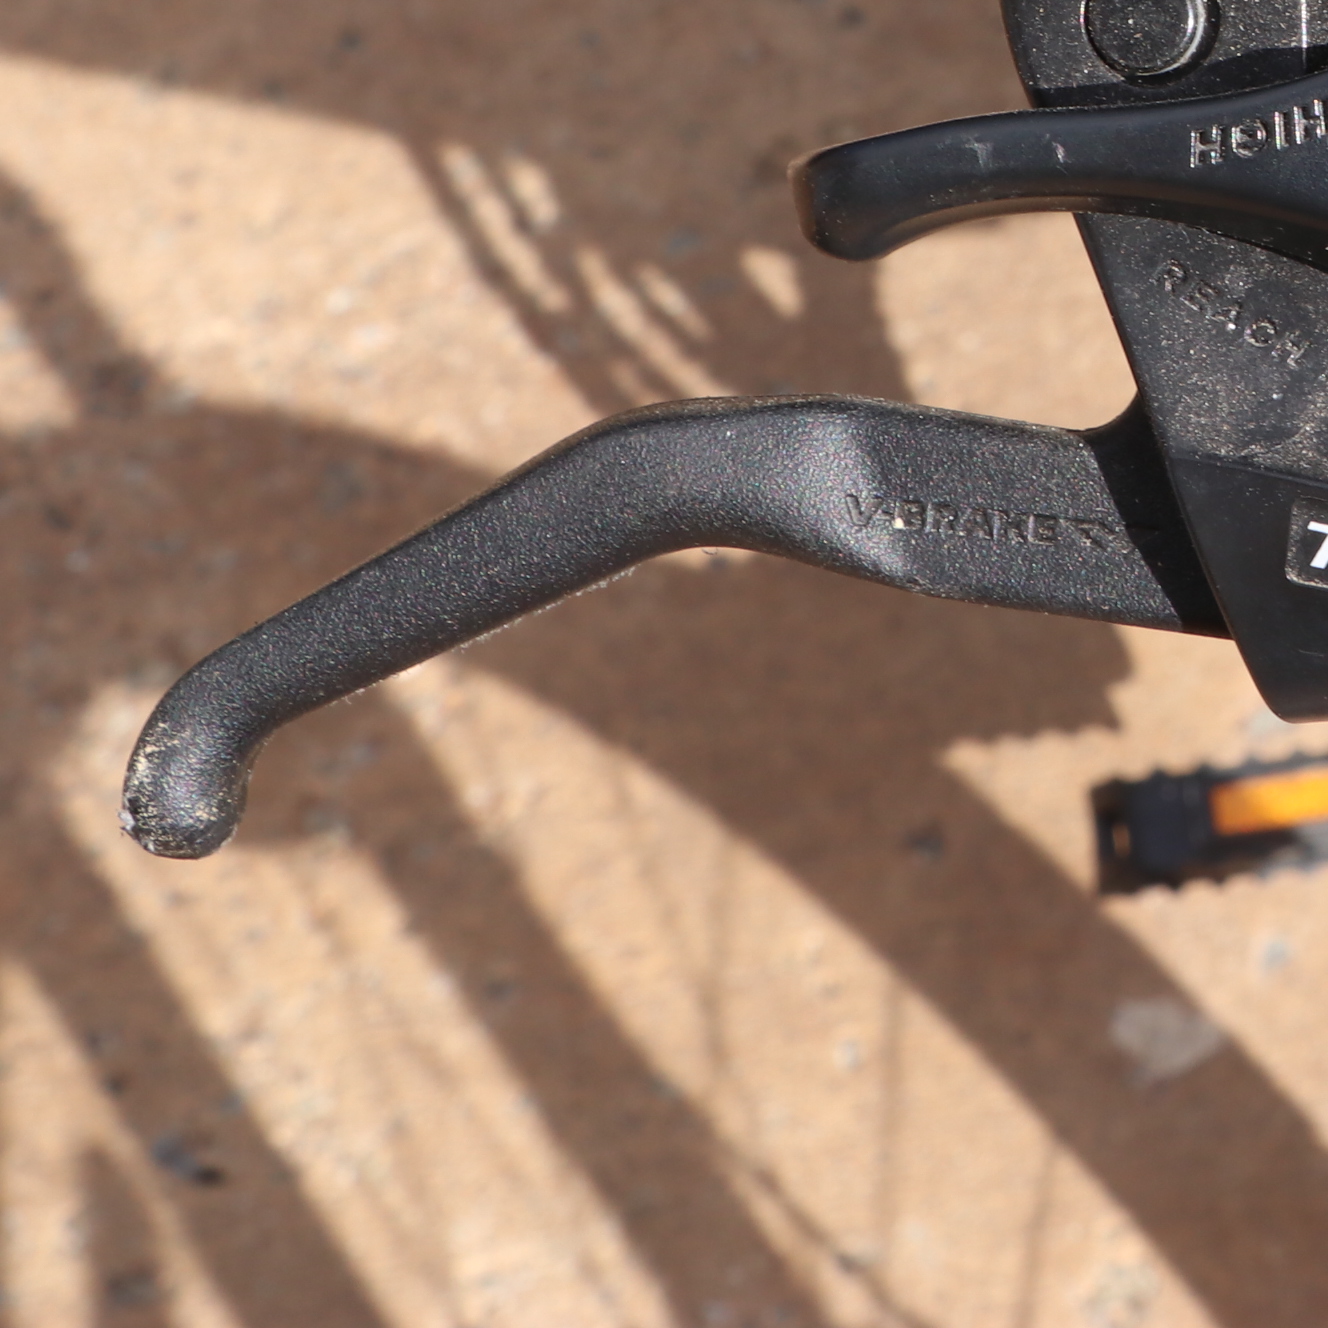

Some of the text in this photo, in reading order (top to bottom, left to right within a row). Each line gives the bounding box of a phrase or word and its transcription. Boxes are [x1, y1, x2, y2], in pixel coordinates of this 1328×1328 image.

[1190, 99, 1328, 169] HIGH
[1151, 259, 1312, 369] REACH
[844, 493, 1058, 548] V-BRAKE
